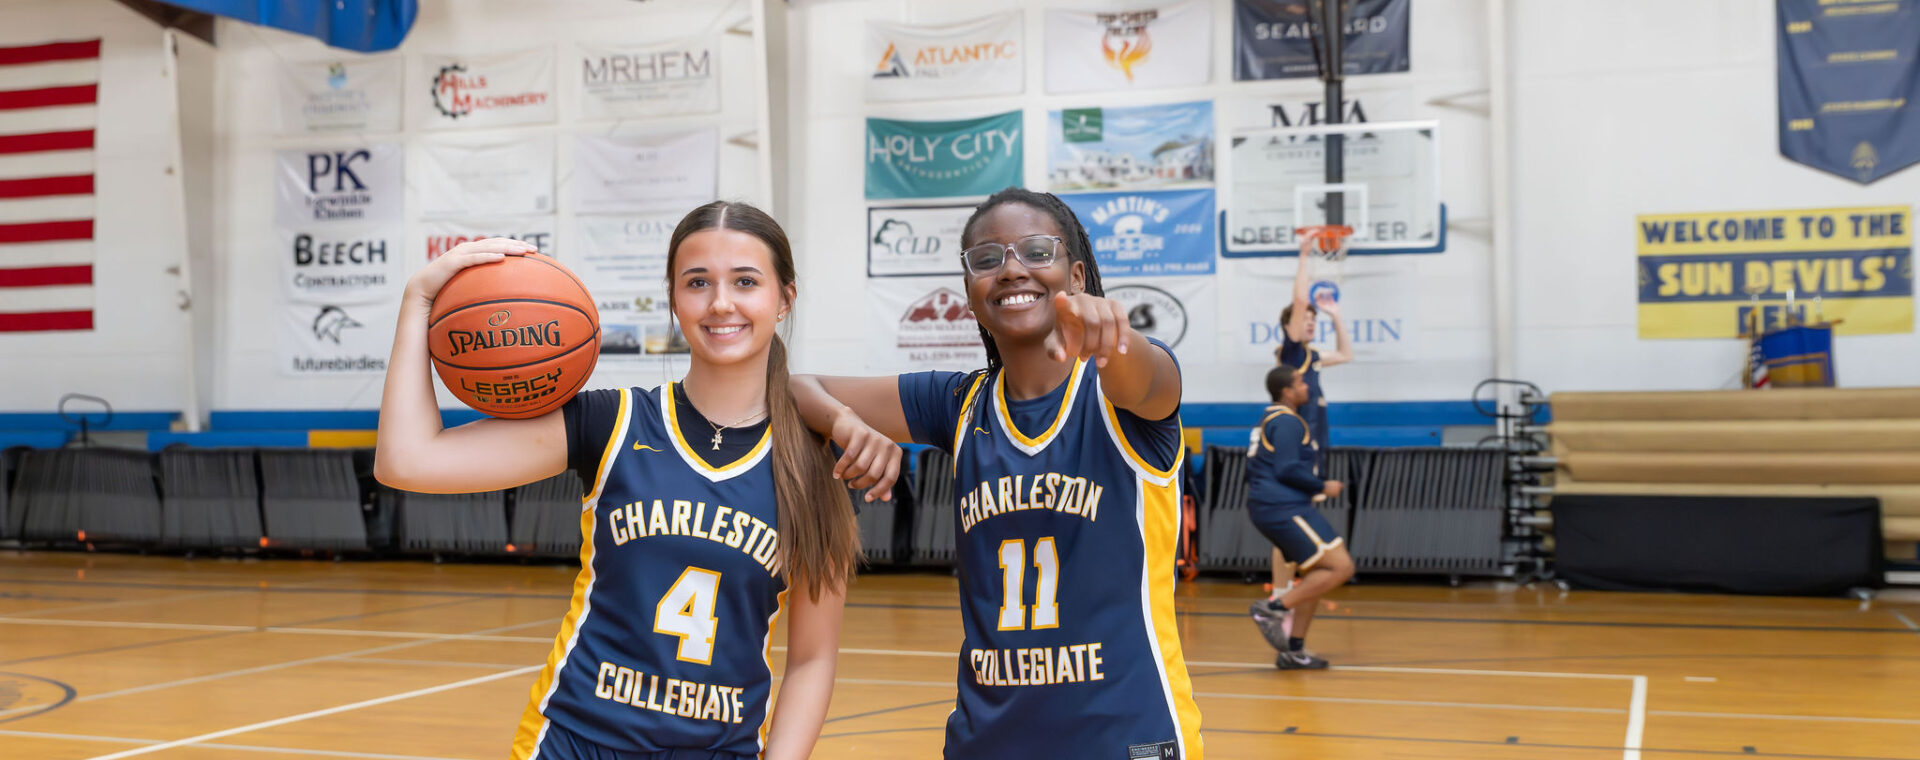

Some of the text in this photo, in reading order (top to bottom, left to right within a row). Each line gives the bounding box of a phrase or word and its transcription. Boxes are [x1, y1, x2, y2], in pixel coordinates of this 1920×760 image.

[915, 41, 1016, 65] ATLANTIC
[453, 93, 547, 113] MACHINERY
[869, 129, 1019, 163] HOLY CITY
[308, 149, 371, 193] PK
[1091, 196, 1169, 225] MARTIN'S
[1642, 213, 1905, 243] WELCOME TO THE
[294, 234, 387, 266] BEECH
[1658, 256, 1896, 296] SUN DEVILS'
[448, 320, 561, 357] SPALDING
[461, 367, 562, 396] LEGACY
[960, 472, 1103, 533] CHARLESTON
[609, 499, 783, 578] CHARLESTON
[997, 536, 1060, 631] 11
[653, 566, 722, 666] 4
[970, 642, 1104, 686] COLLEGIATE
[595, 661, 744, 724] COLLEGIATE
[1165, 747, 1174, 758] M
